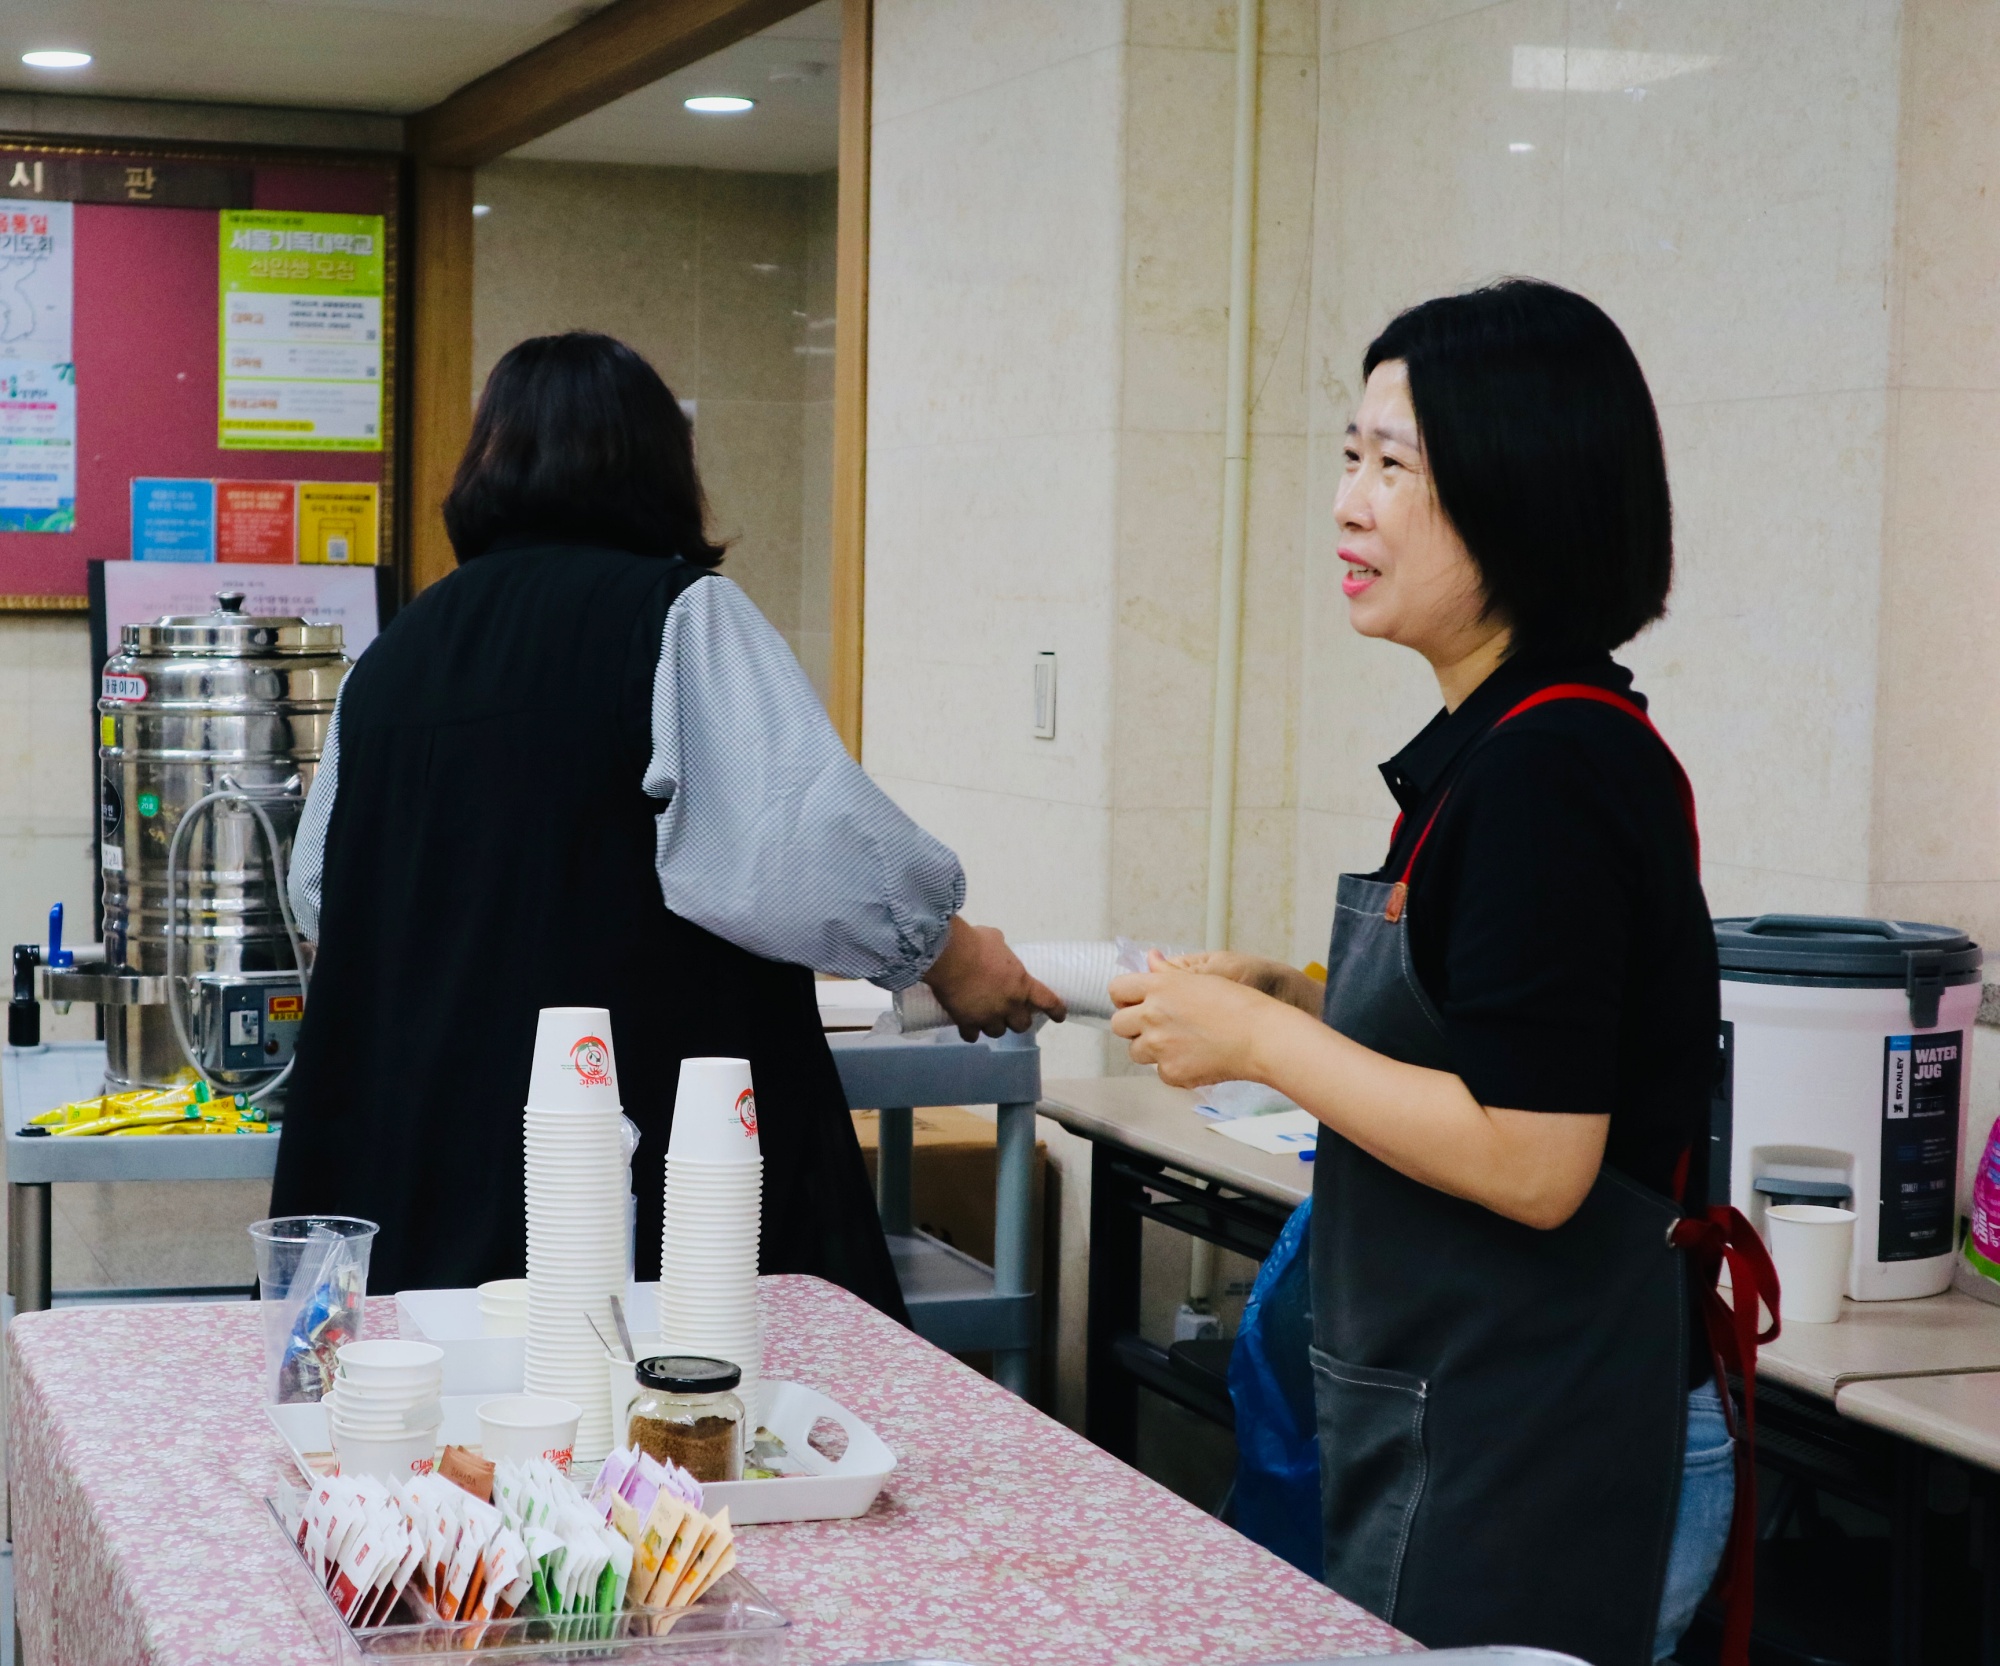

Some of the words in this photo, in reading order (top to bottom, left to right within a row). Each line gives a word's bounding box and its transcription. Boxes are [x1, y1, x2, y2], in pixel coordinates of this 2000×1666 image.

[9, 161, 44, 194] 시
[125, 166, 157, 200] 판
[231, 229, 374, 256] 서울기독대학교
[1915, 1045, 1957, 1064] WATER
[579, 1076, 613, 1088] Classic
[1895, 1057, 1904, 1100] STANLEY
[1914, 1064, 1942, 1080] JUG
